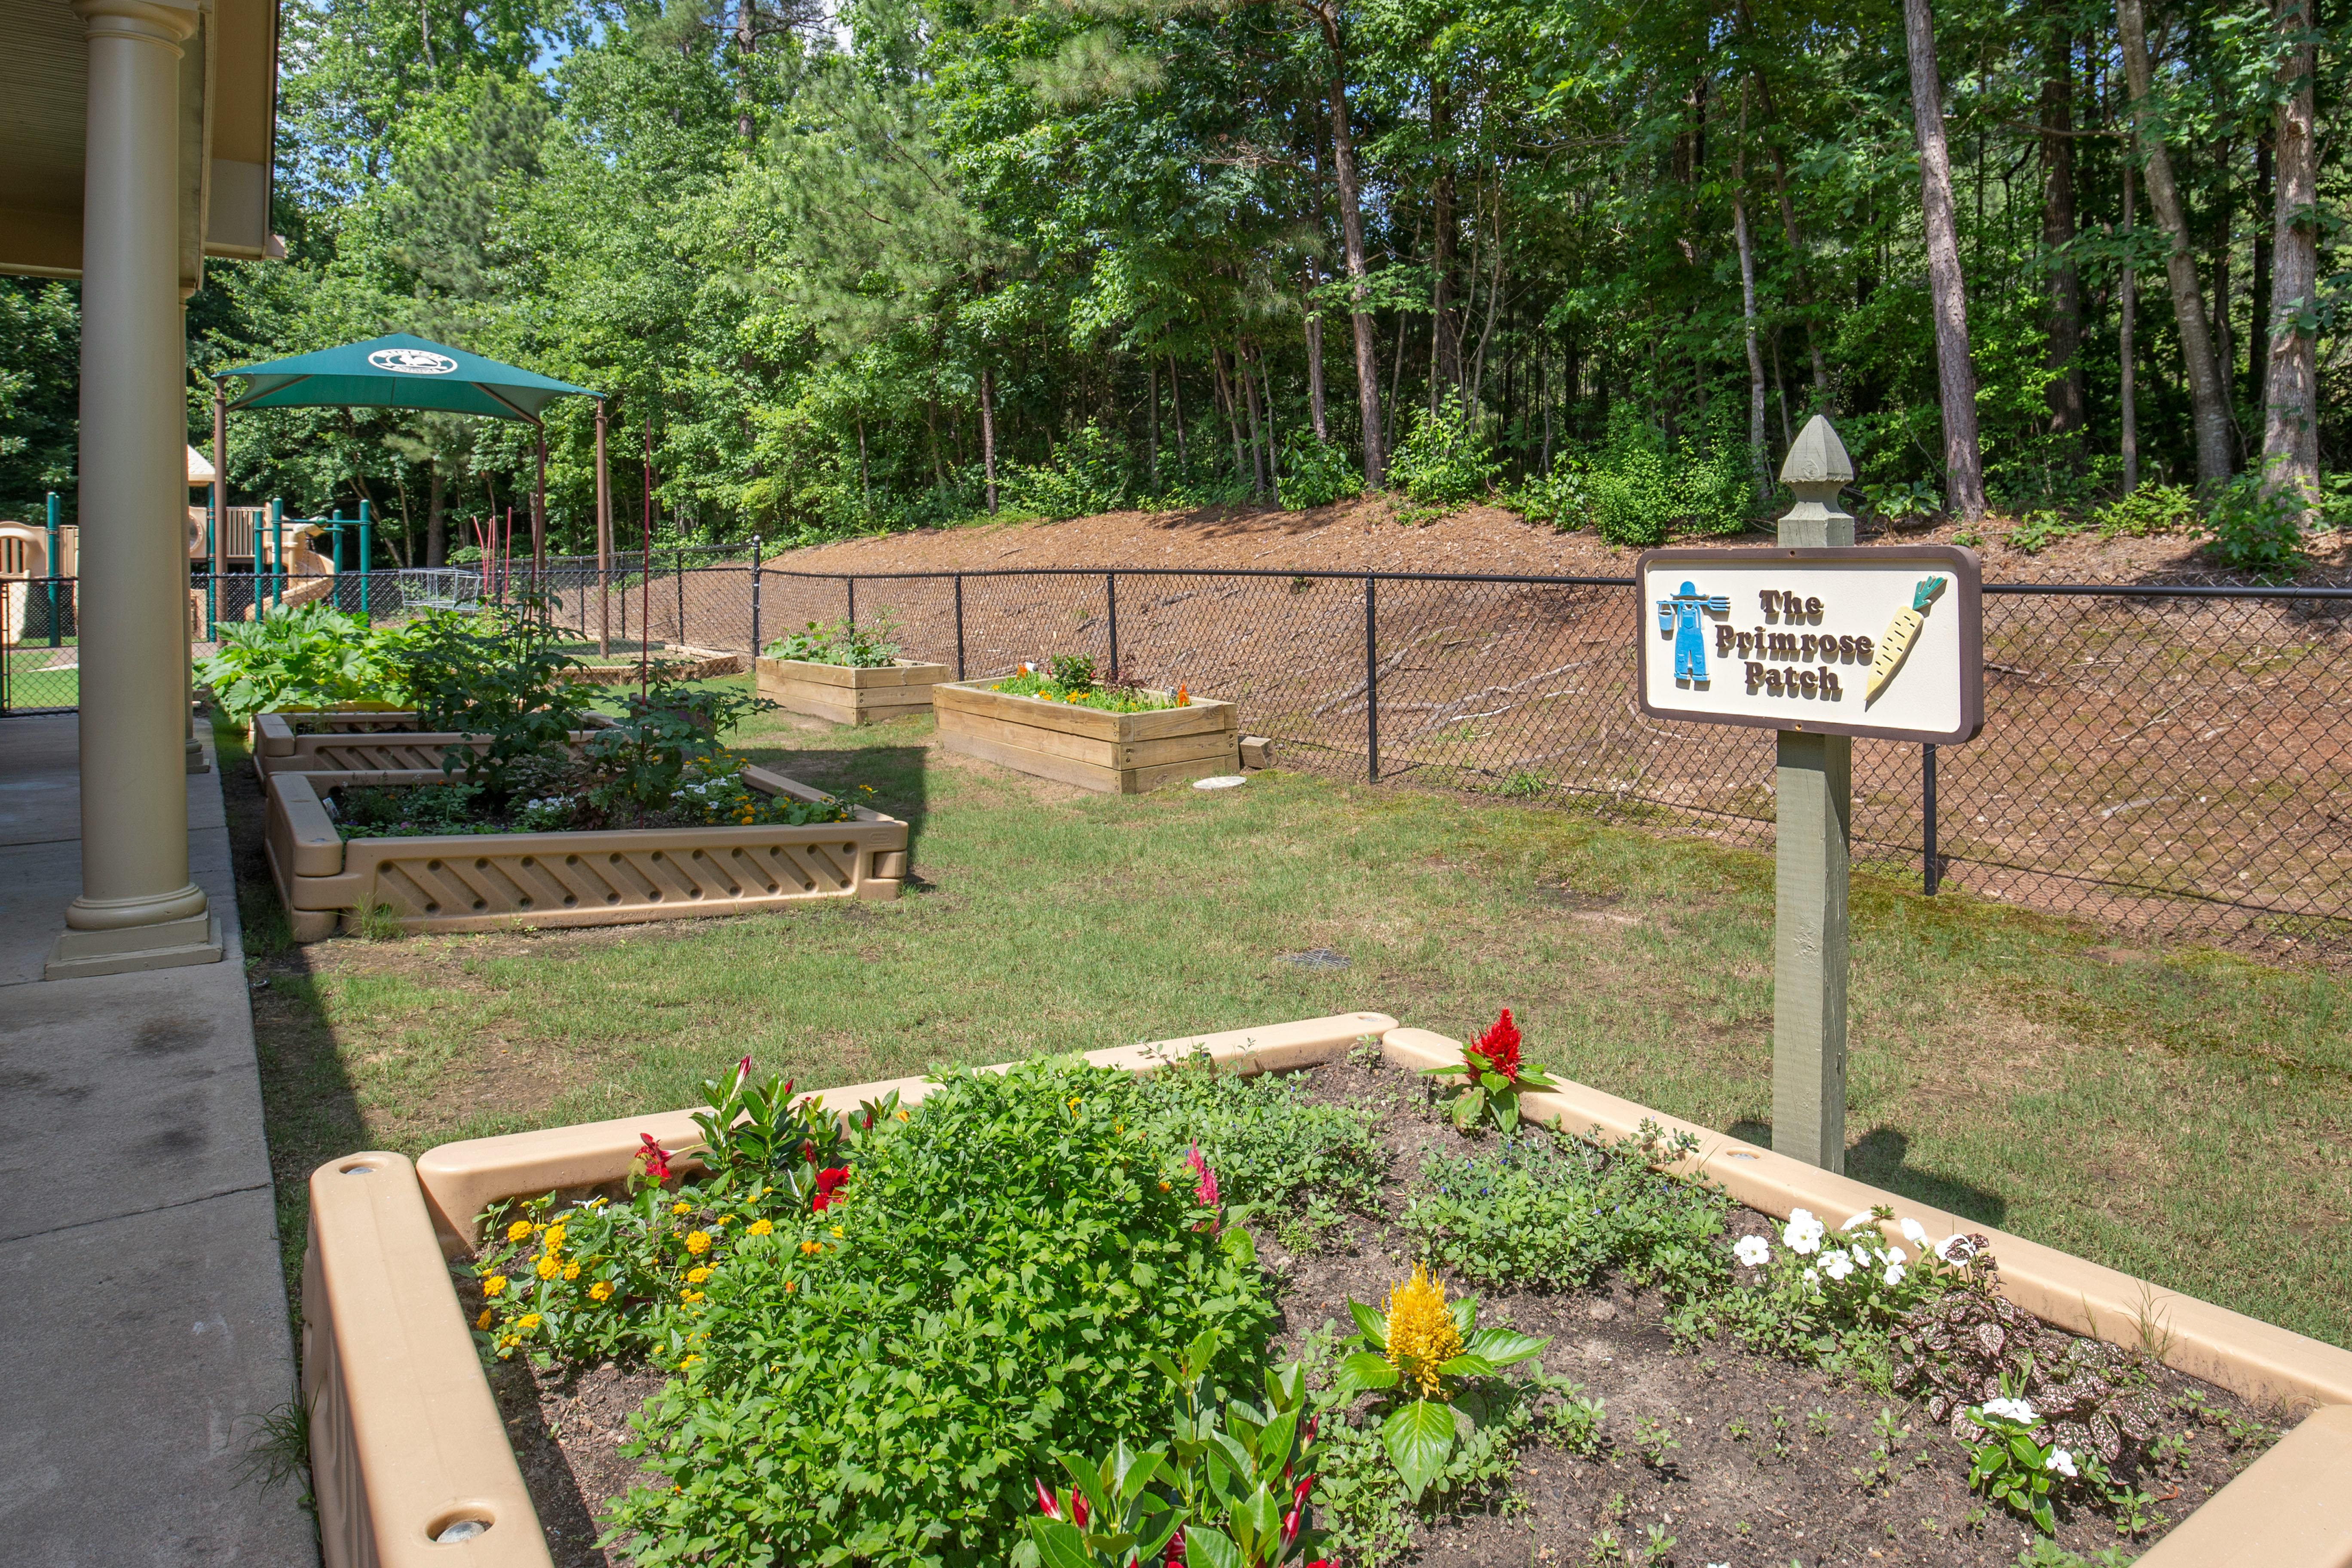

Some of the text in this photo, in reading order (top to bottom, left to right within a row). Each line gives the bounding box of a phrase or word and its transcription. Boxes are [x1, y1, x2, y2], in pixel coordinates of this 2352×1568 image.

[1759, 589, 1823, 614] The
[1715, 625, 1873, 654] Primrose
[1744, 662, 1842, 691] Patch
